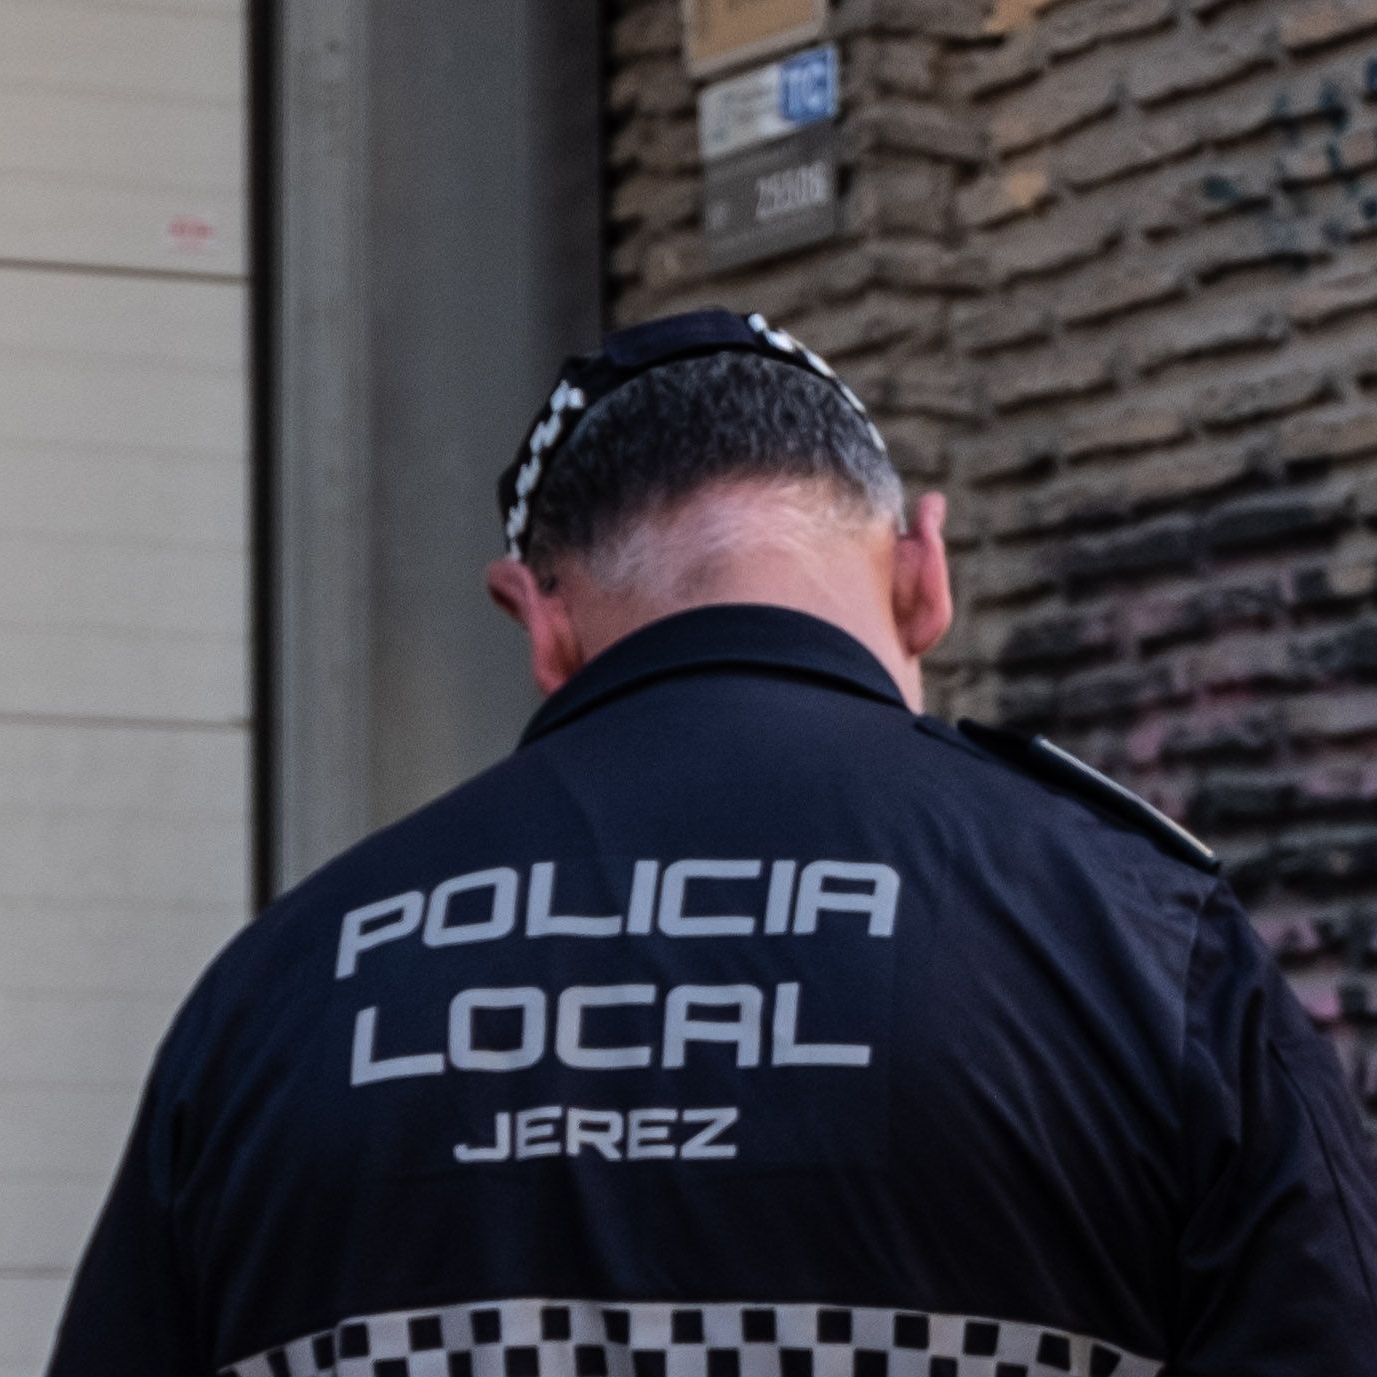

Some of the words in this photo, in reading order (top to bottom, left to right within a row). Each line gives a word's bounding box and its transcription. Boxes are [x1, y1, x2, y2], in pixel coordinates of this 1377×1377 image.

[336, 860, 899, 978] POLICIA
[351, 983, 870, 1086] LOCAL
[454, 1106, 739, 1162] JEREZ
